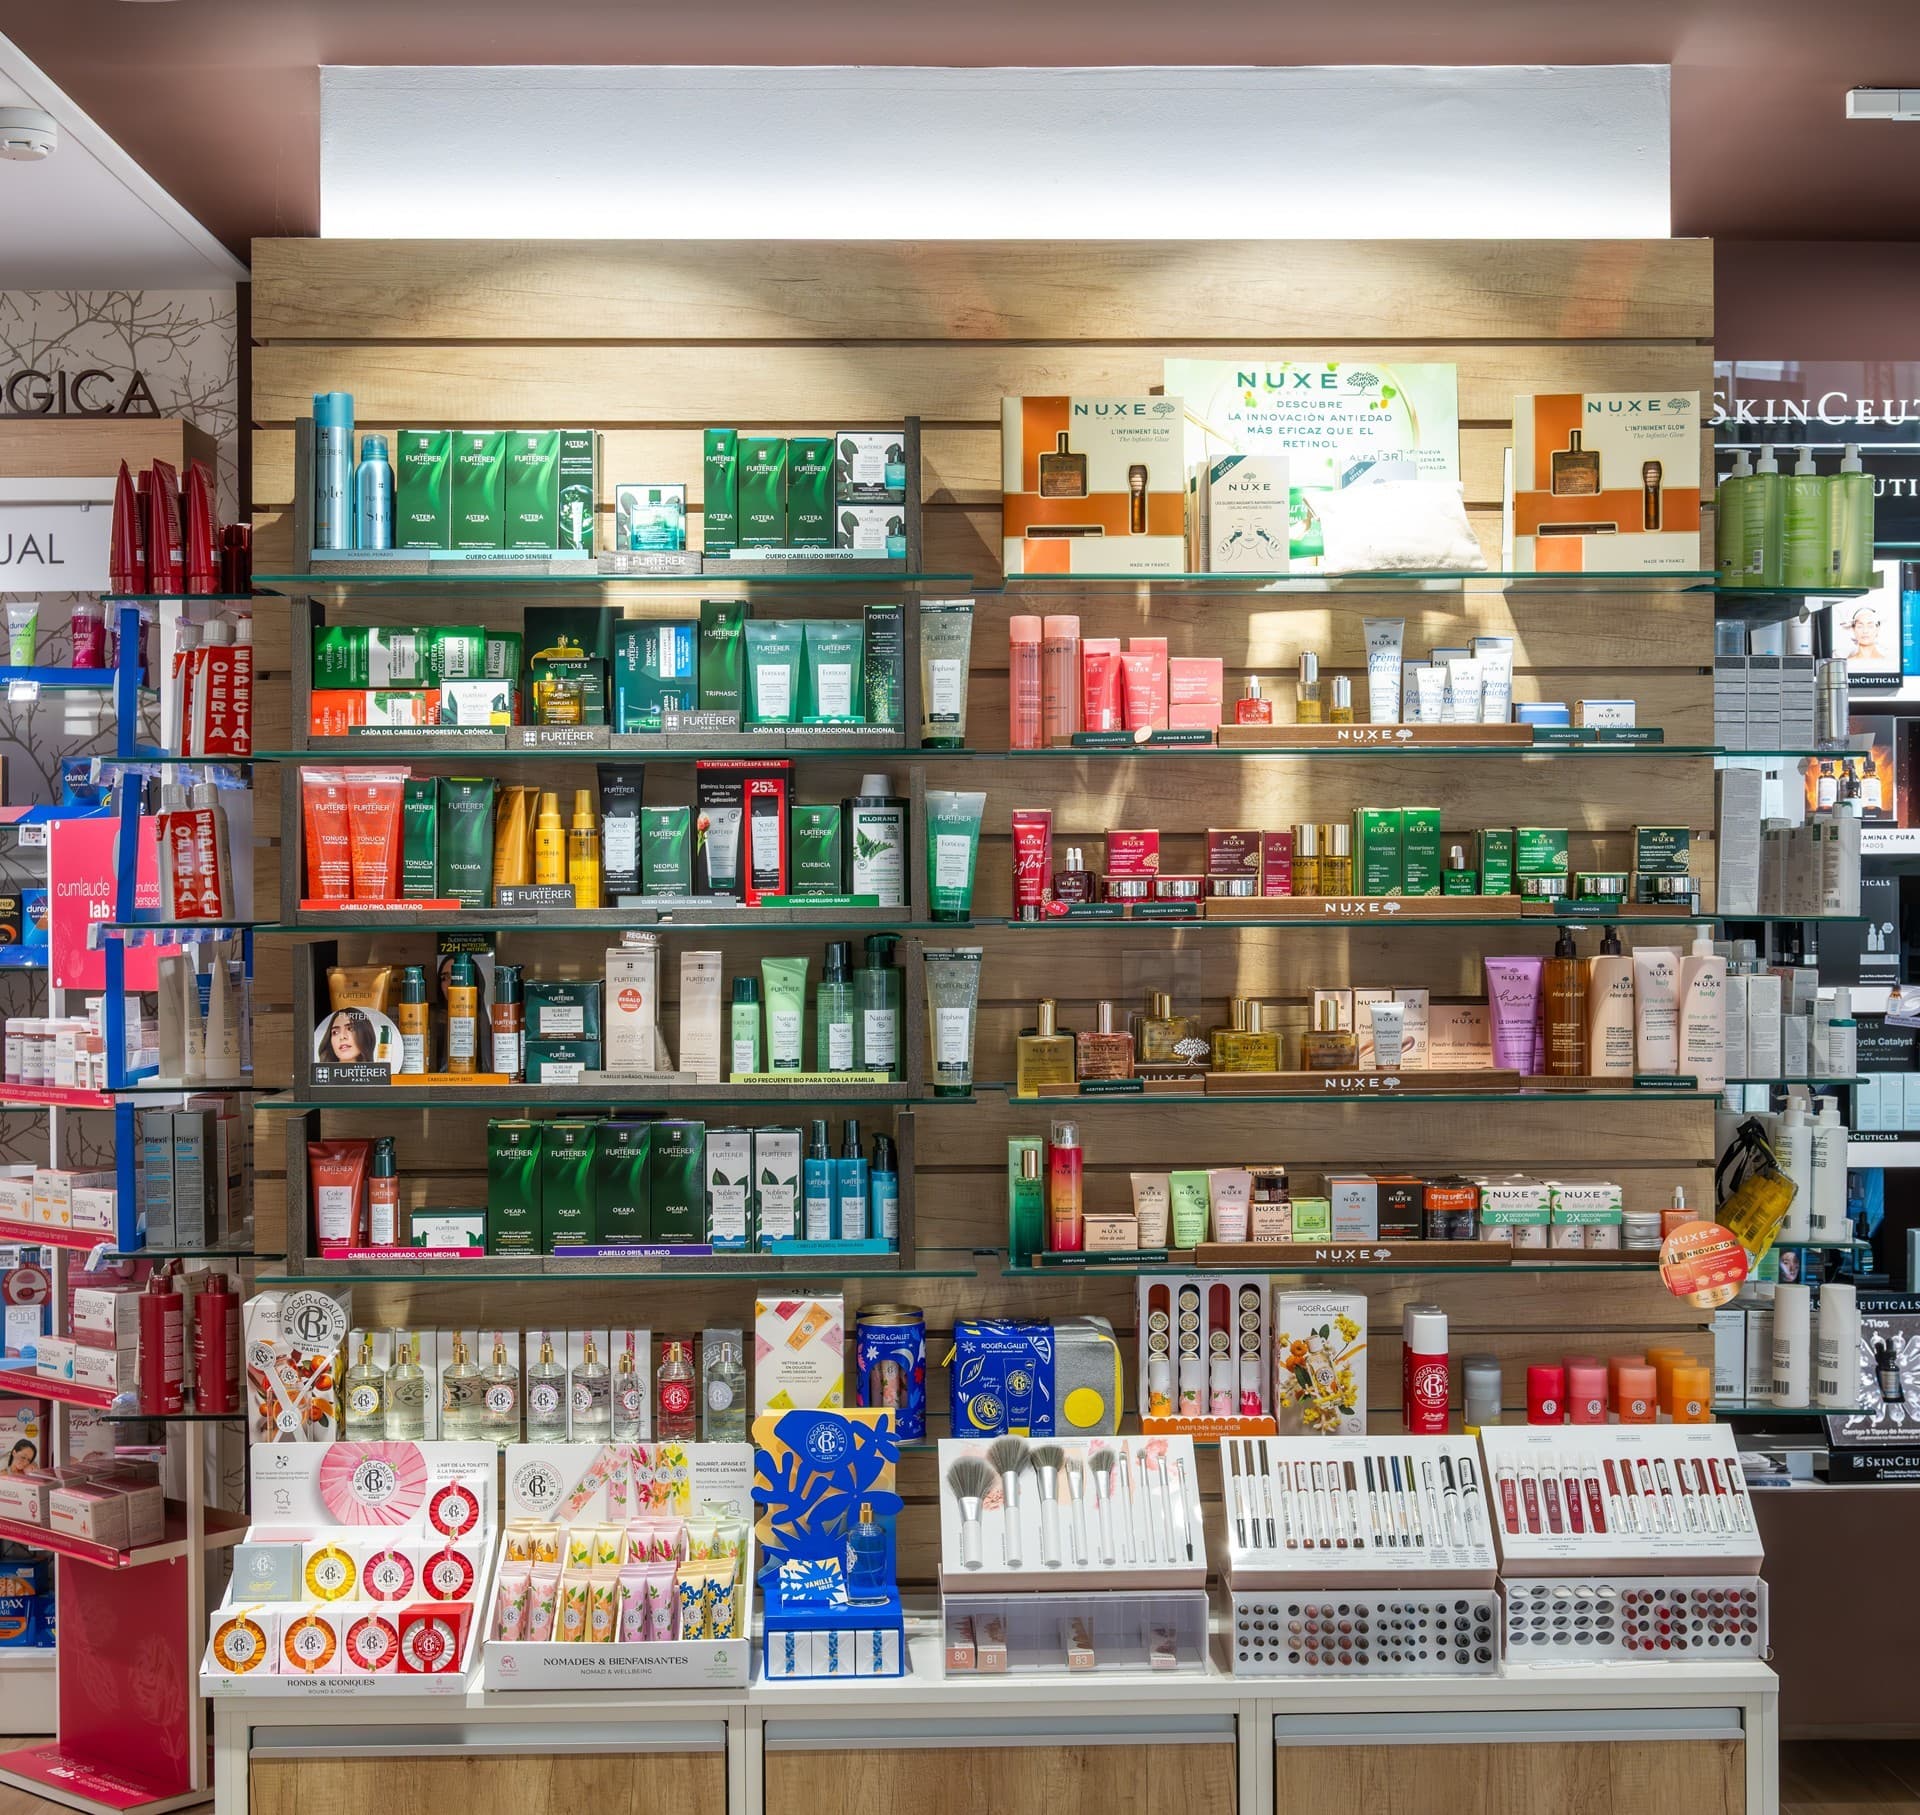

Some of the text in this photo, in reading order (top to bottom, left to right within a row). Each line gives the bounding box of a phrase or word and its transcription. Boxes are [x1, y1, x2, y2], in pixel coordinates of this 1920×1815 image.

[1237, 372, 1338, 388] NUXE
[0, 369, 161, 417] GICA
[1074, 404, 1146, 415] NUXE
[1588, 400, 1661, 413] NUXE
[1246, 413, 1325, 421] INNOVACIÓN
[1330, 414, 1392, 422] ANTIEDAD
[1247, 425, 1273, 435] MÁS
[1327, 427, 1353, 435] QUE
[1360, 427, 1374, 435] EL
[1283, 440, 1338, 448] RETINOL
[405, 455, 442, 463] FURTERER
[1229, 483, 1271, 491] NUXE
[632, 556, 685, 566] FURTERER
[9, 621, 29, 630] durex
[704, 630, 739, 638] FURTERER
[1369, 653, 1400, 662] Crème
[1848, 676, 1900, 684] KINCEUTICALS
[210, 661, 227, 738] OFERTA
[231, 650, 249, 752] ESPECIAL
[683, 717, 736, 726] FURTERER
[541, 732, 594, 741] FURTERER
[1338, 730, 1392, 739] NUXE
[65, 773, 88, 781] durex
[57, 878, 110, 896] cumlaude
[518, 890, 572, 900] FURTERER
[1325, 903, 1379, 912] NUXE
[626, 931, 656, 940] REGALO
[440, 943, 461, 952] 72H
[1877, 1037, 1913, 1047] Catalyst
[334, 1068, 387, 1078] FURTERER
[145, 1136, 168, 1144] Pilexil
[1495, 1213, 1509, 1223] 2X
[1668, 1231, 1708, 1246] NUXE
[1316, 1250, 1370, 1259] NUXE
[284, 1293, 345, 1331] ROGER&GALLET
[1297, 1305, 1350, 1313] ROGER&GALLET
[866, 1333, 910, 1341] ROGER&GALLET
[804, 1576, 833, 1589] VANILLE
[954, 1651, 967, 1661] 80
[986, 1654, 998, 1664] 81
[1075, 1655, 1087, 1665] 83
[543, 1657, 689, 1666] NOMADES & BIENFAISANTES
[329, 1679, 376, 1687] ICONIQUES
